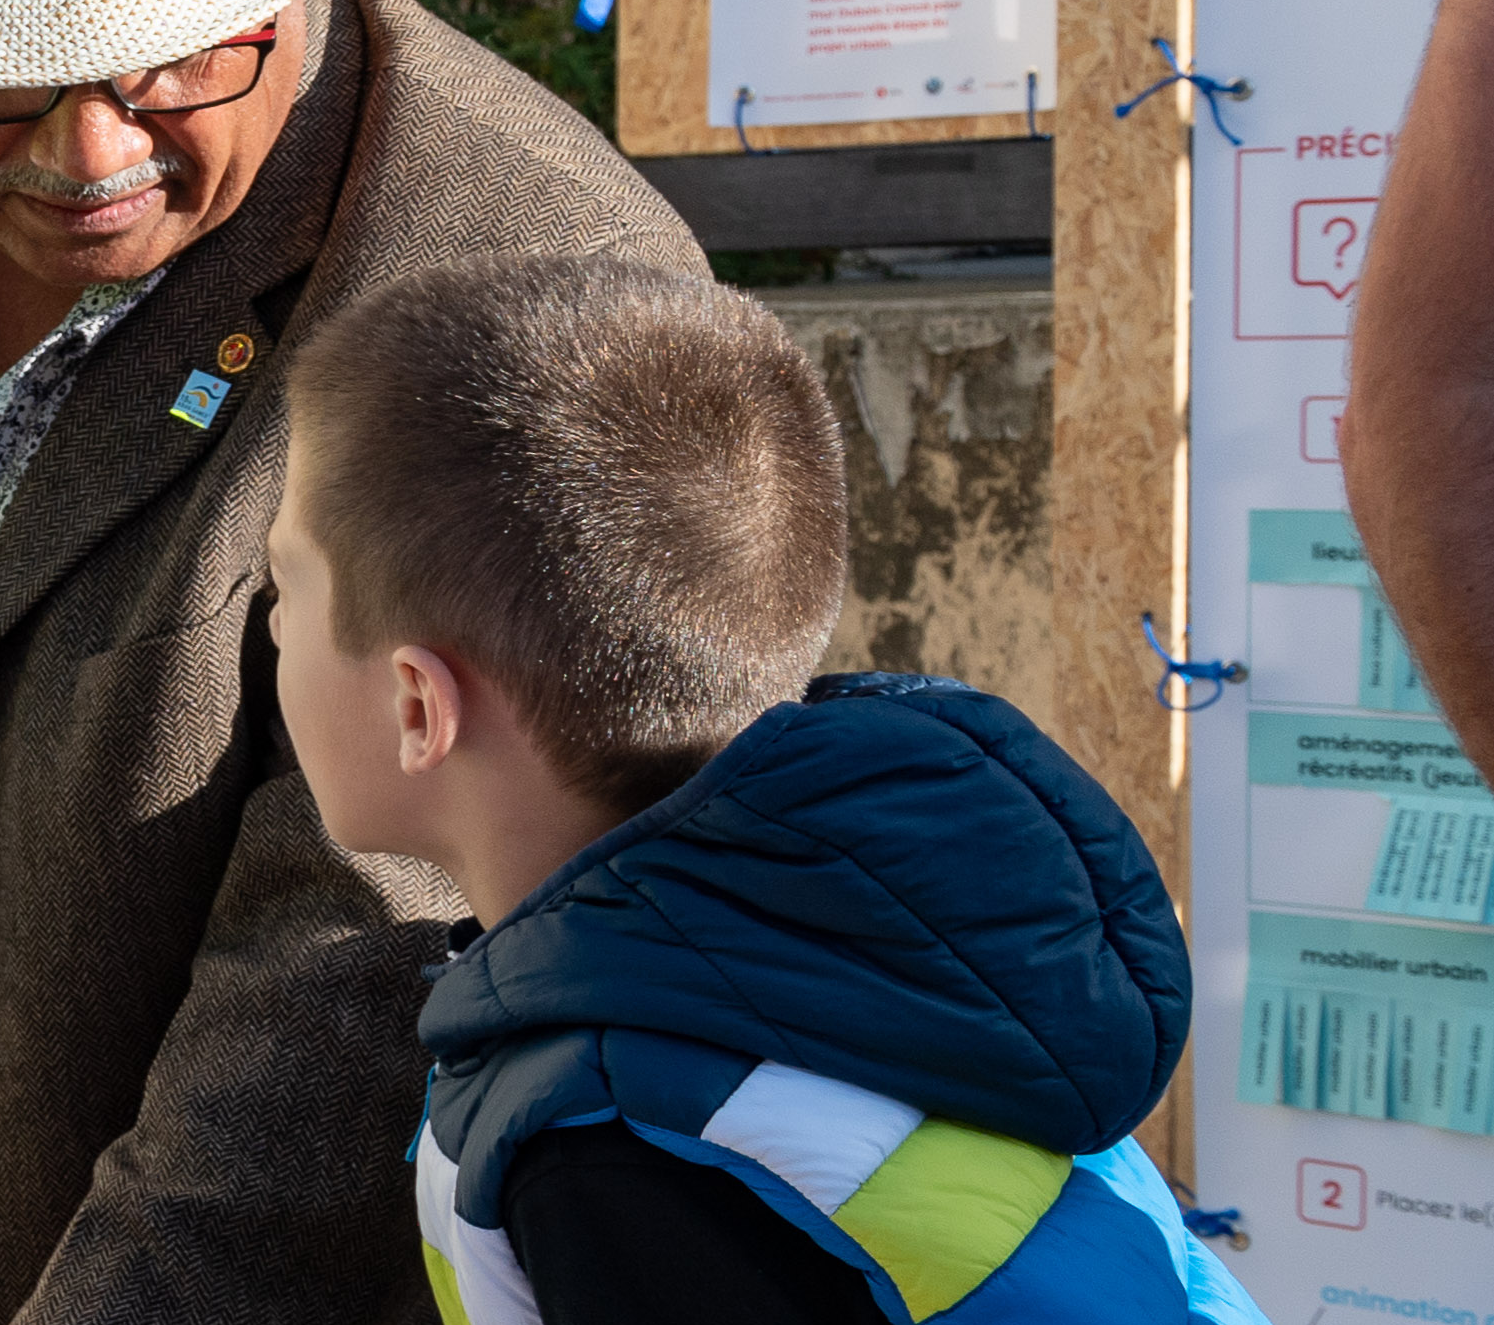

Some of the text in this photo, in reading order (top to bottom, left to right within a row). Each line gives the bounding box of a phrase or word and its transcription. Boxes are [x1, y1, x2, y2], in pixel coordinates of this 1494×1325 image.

[1297, 758, 1417, 784] récréatifs
[1299, 947, 1489, 983] mobilier urbain
[1322, 1179, 1344, 1210] 2
[1375, 1189, 1456, 1221] Placez
